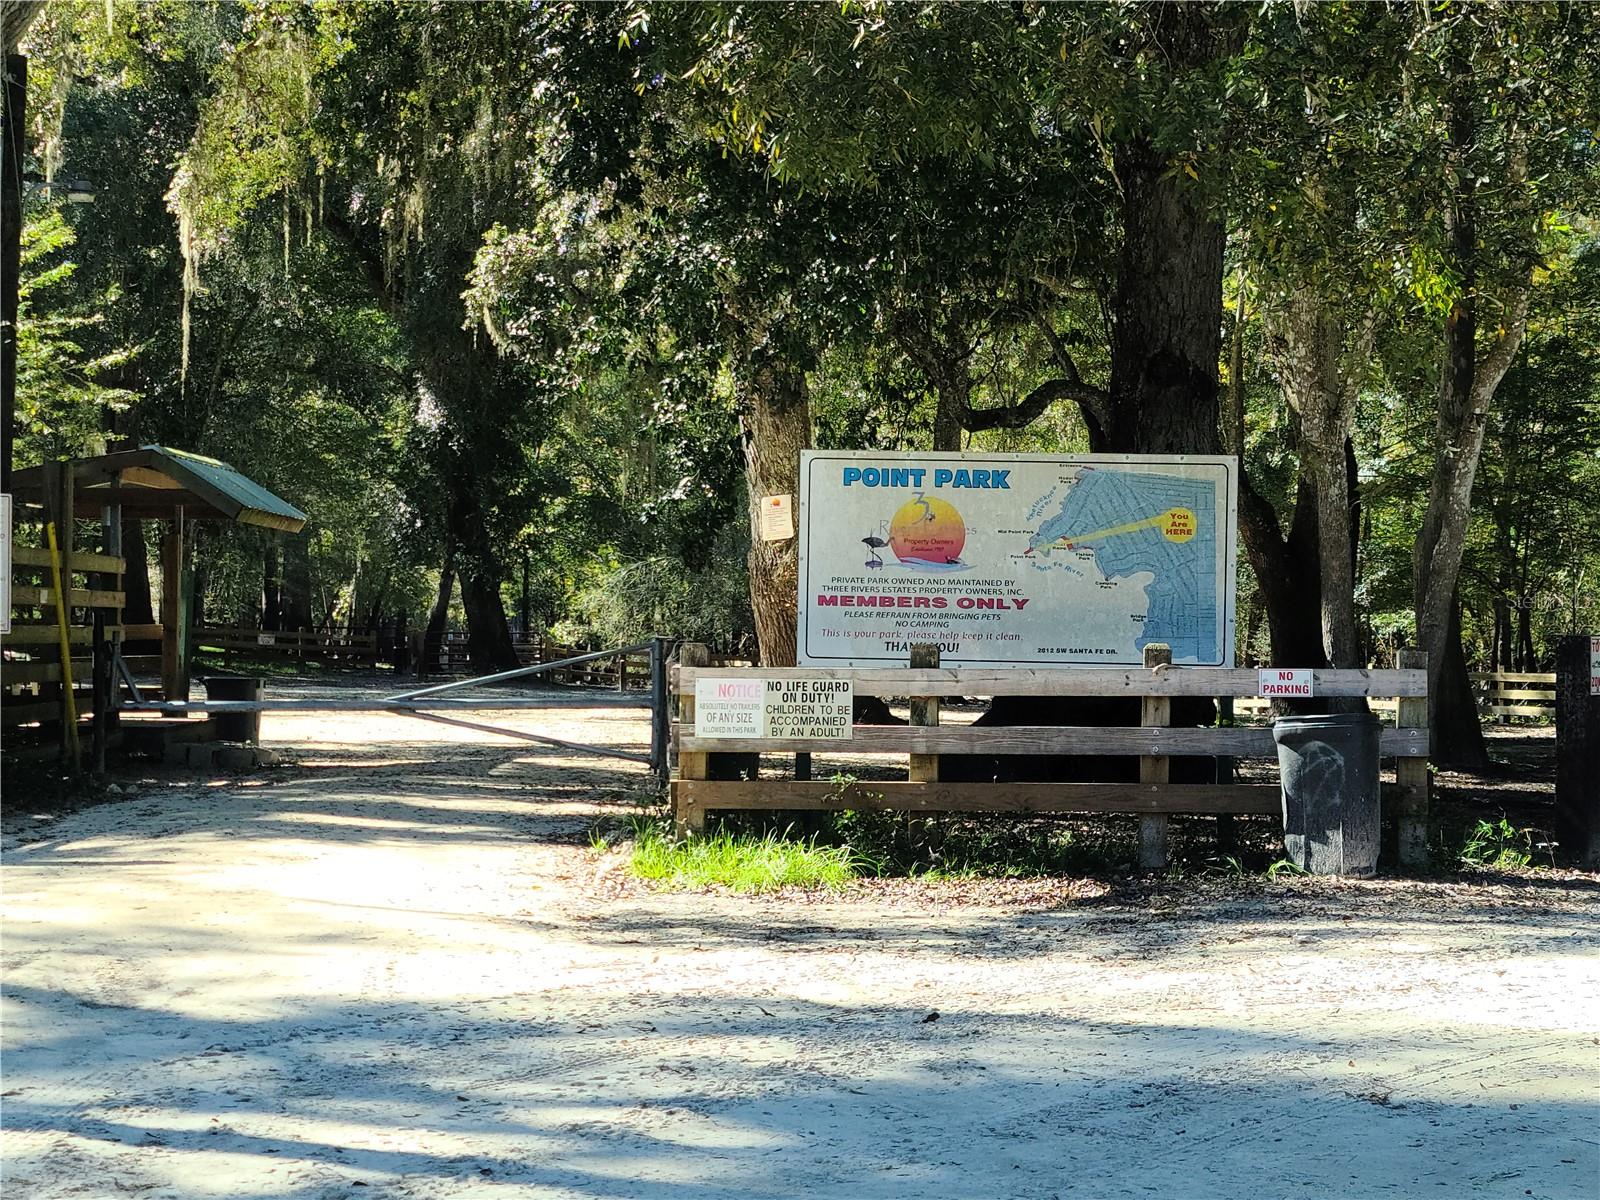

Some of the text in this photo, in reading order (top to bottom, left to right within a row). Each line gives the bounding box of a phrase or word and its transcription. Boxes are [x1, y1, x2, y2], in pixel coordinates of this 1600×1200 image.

[843, 467, 1011, 489] POINT PARK
[831, 576, 865, 584] PRIVATE
[891, 577, 924, 585] OWNED
[918, 587, 963, 595] PROPERTY
[965, 588, 1005, 596] OWNERS,
[1007, 588, 1024, 596] INC.
[817, 594, 1030, 610] MEMBERS ONLY
[844, 610, 874, 618] PLEASE
[875, 611, 911, 619] REFRAIN
[938, 612, 979, 620] BRINGING
[895, 620, 908, 628] NO
[821, 628, 840, 638] This
[843, 629, 851, 638] is
[854, 631, 877, 639] your
[907, 630, 937, 640] please
[939, 631, 959, 641] help
[962, 631, 983, 641] keep
[986, 632, 993, 640] it
[995, 632, 1024, 641] clean.
[1278, 671, 1293, 681] NO
[718, 683, 761, 698] NOTICE
[767, 681, 849, 693] NO LIFE GUARD
[1263, 684, 1310, 694] PARKING
[782, 692, 835, 704] ON DUTY!
[699, 702, 761, 711] ABSOLUTELY NO TRAILERS
[765, 704, 851, 715] CHILDREN TO BE
[706, 712, 753, 724] OF ANY SIZE
[769, 716, 847, 726] ACCOMPANIED
[702, 726, 757, 734] ALLOWED IN THIS PARK
[771, 727, 844, 738] BY AN ADULT!
